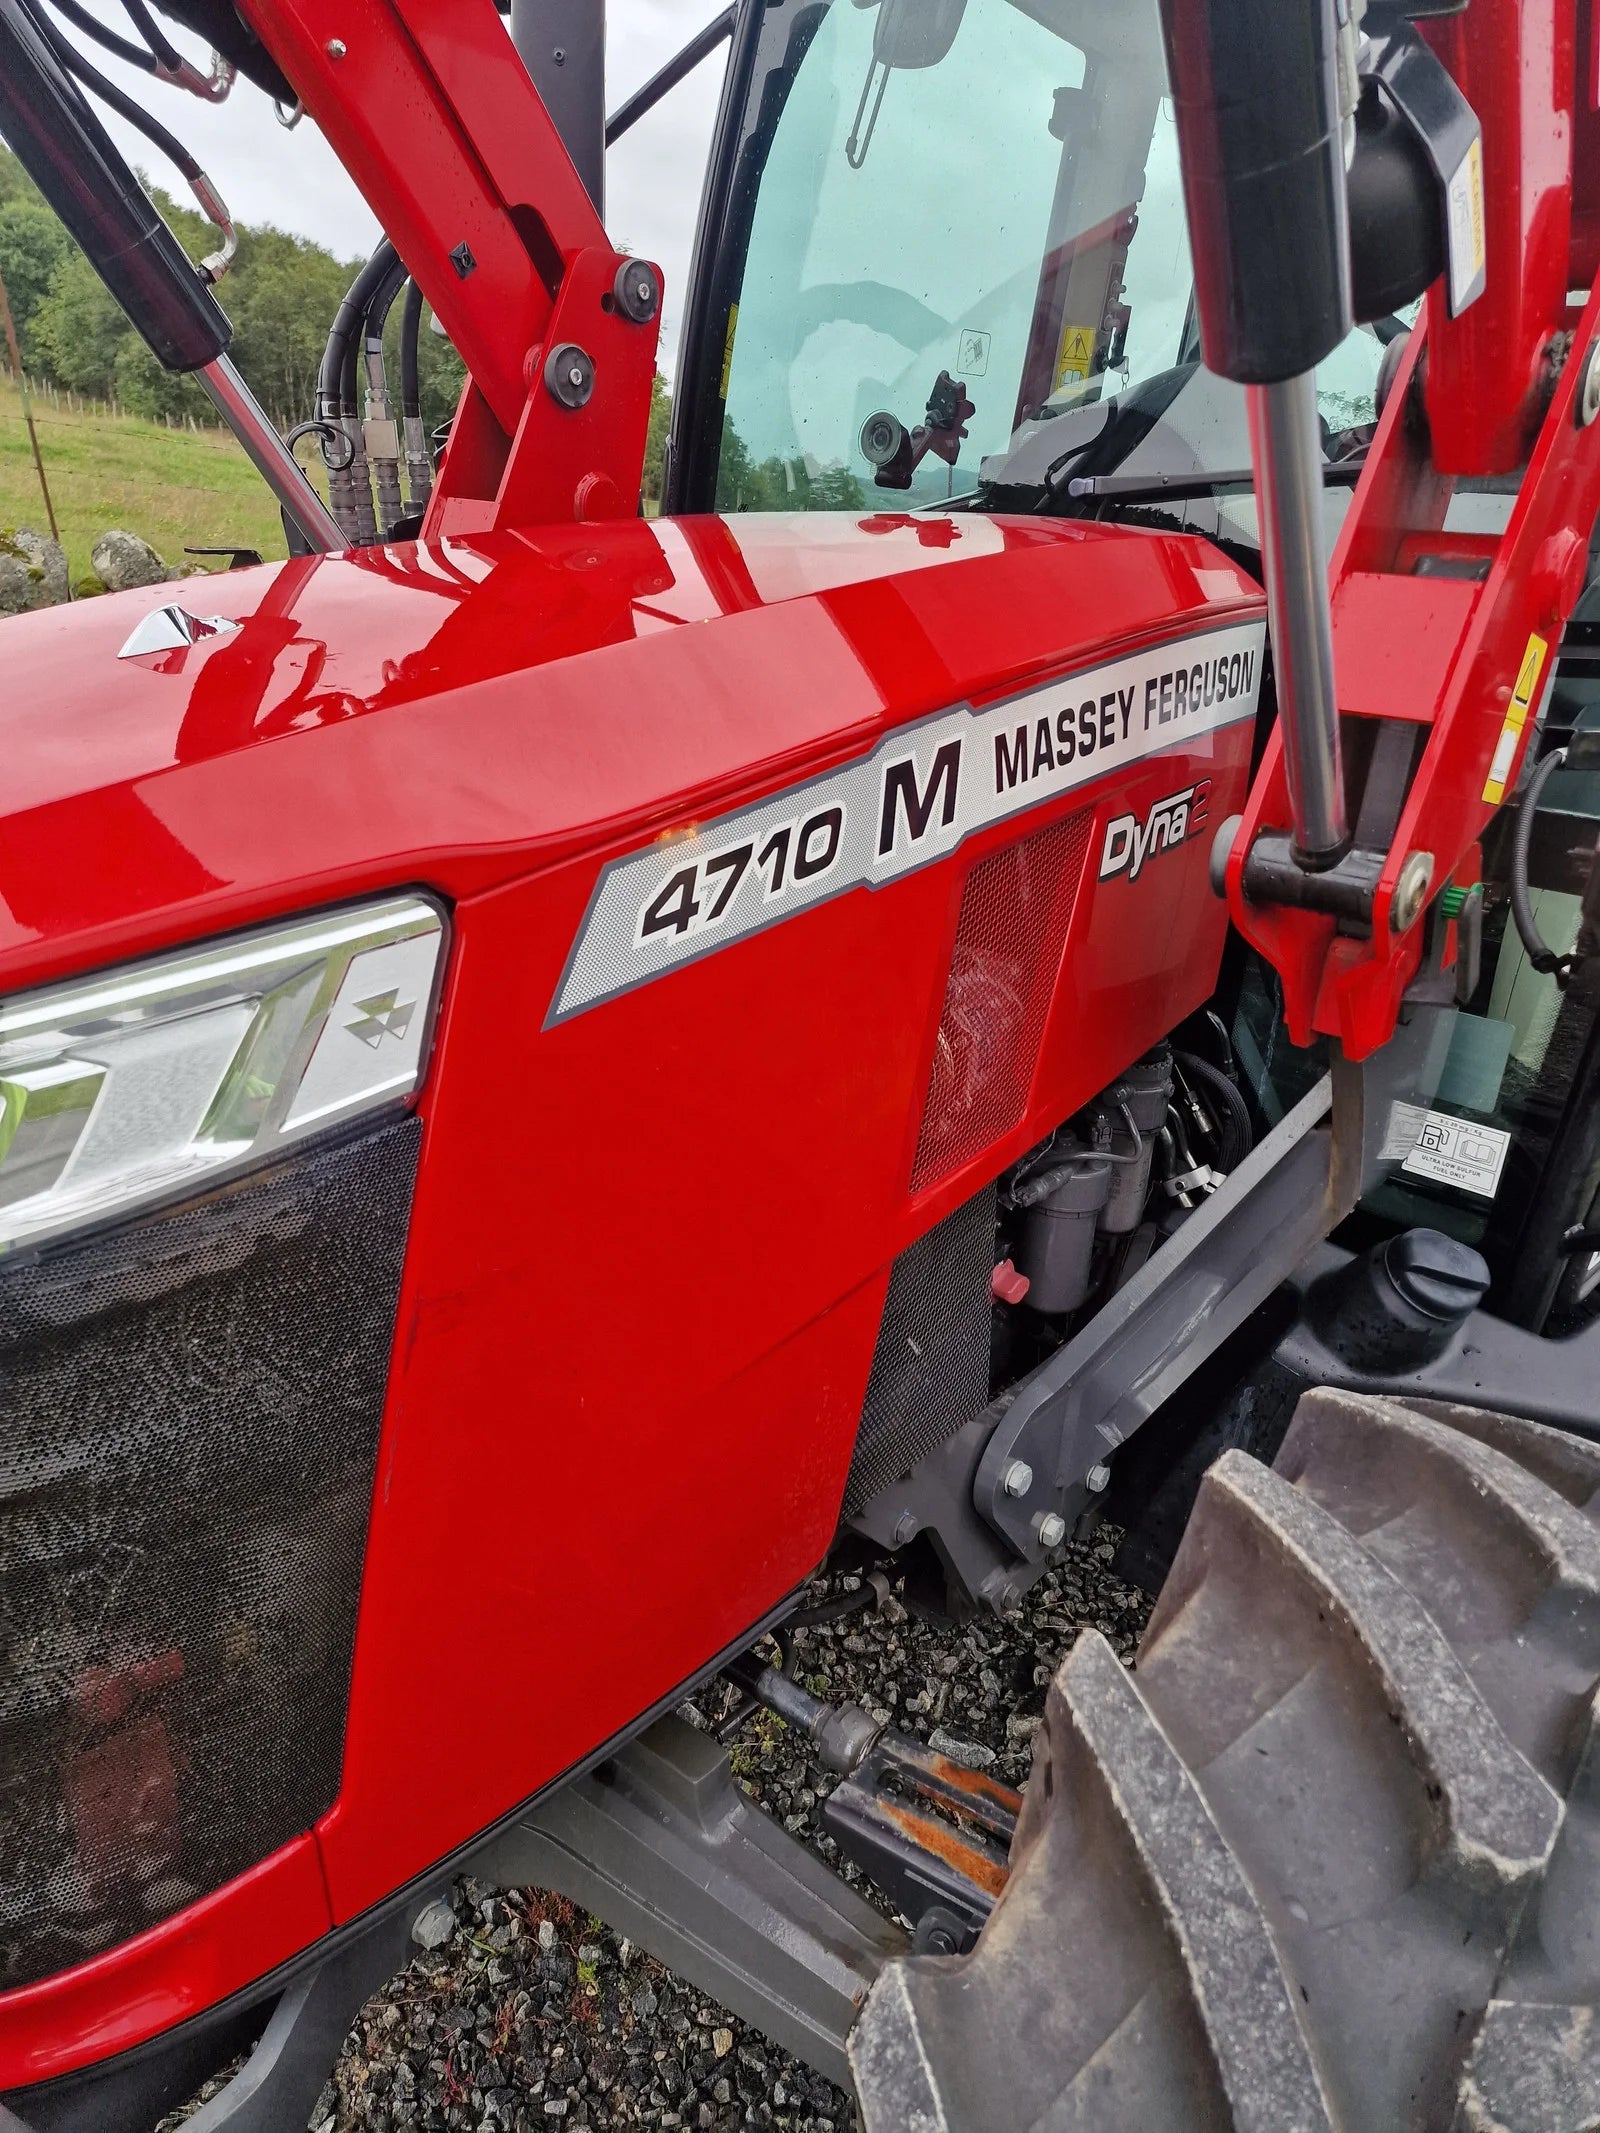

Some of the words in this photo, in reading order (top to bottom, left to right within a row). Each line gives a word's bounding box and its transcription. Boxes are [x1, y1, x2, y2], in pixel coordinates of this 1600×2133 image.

[994, 685, 1136, 794] MASSEY
[1143, 650, 1255, 731] FERGUSON
[641, 807, 843, 938] 4710
[879, 739, 962, 856] M
[1421, 1154, 1441, 1165] ULTRA
[1442, 1160, 1456, 1169] LOW
[1456, 1164, 1481, 1178] SULFUR
[1433, 1165, 1448, 1175] FUEL
[1449, 1170, 1467, 1180] ONLY
